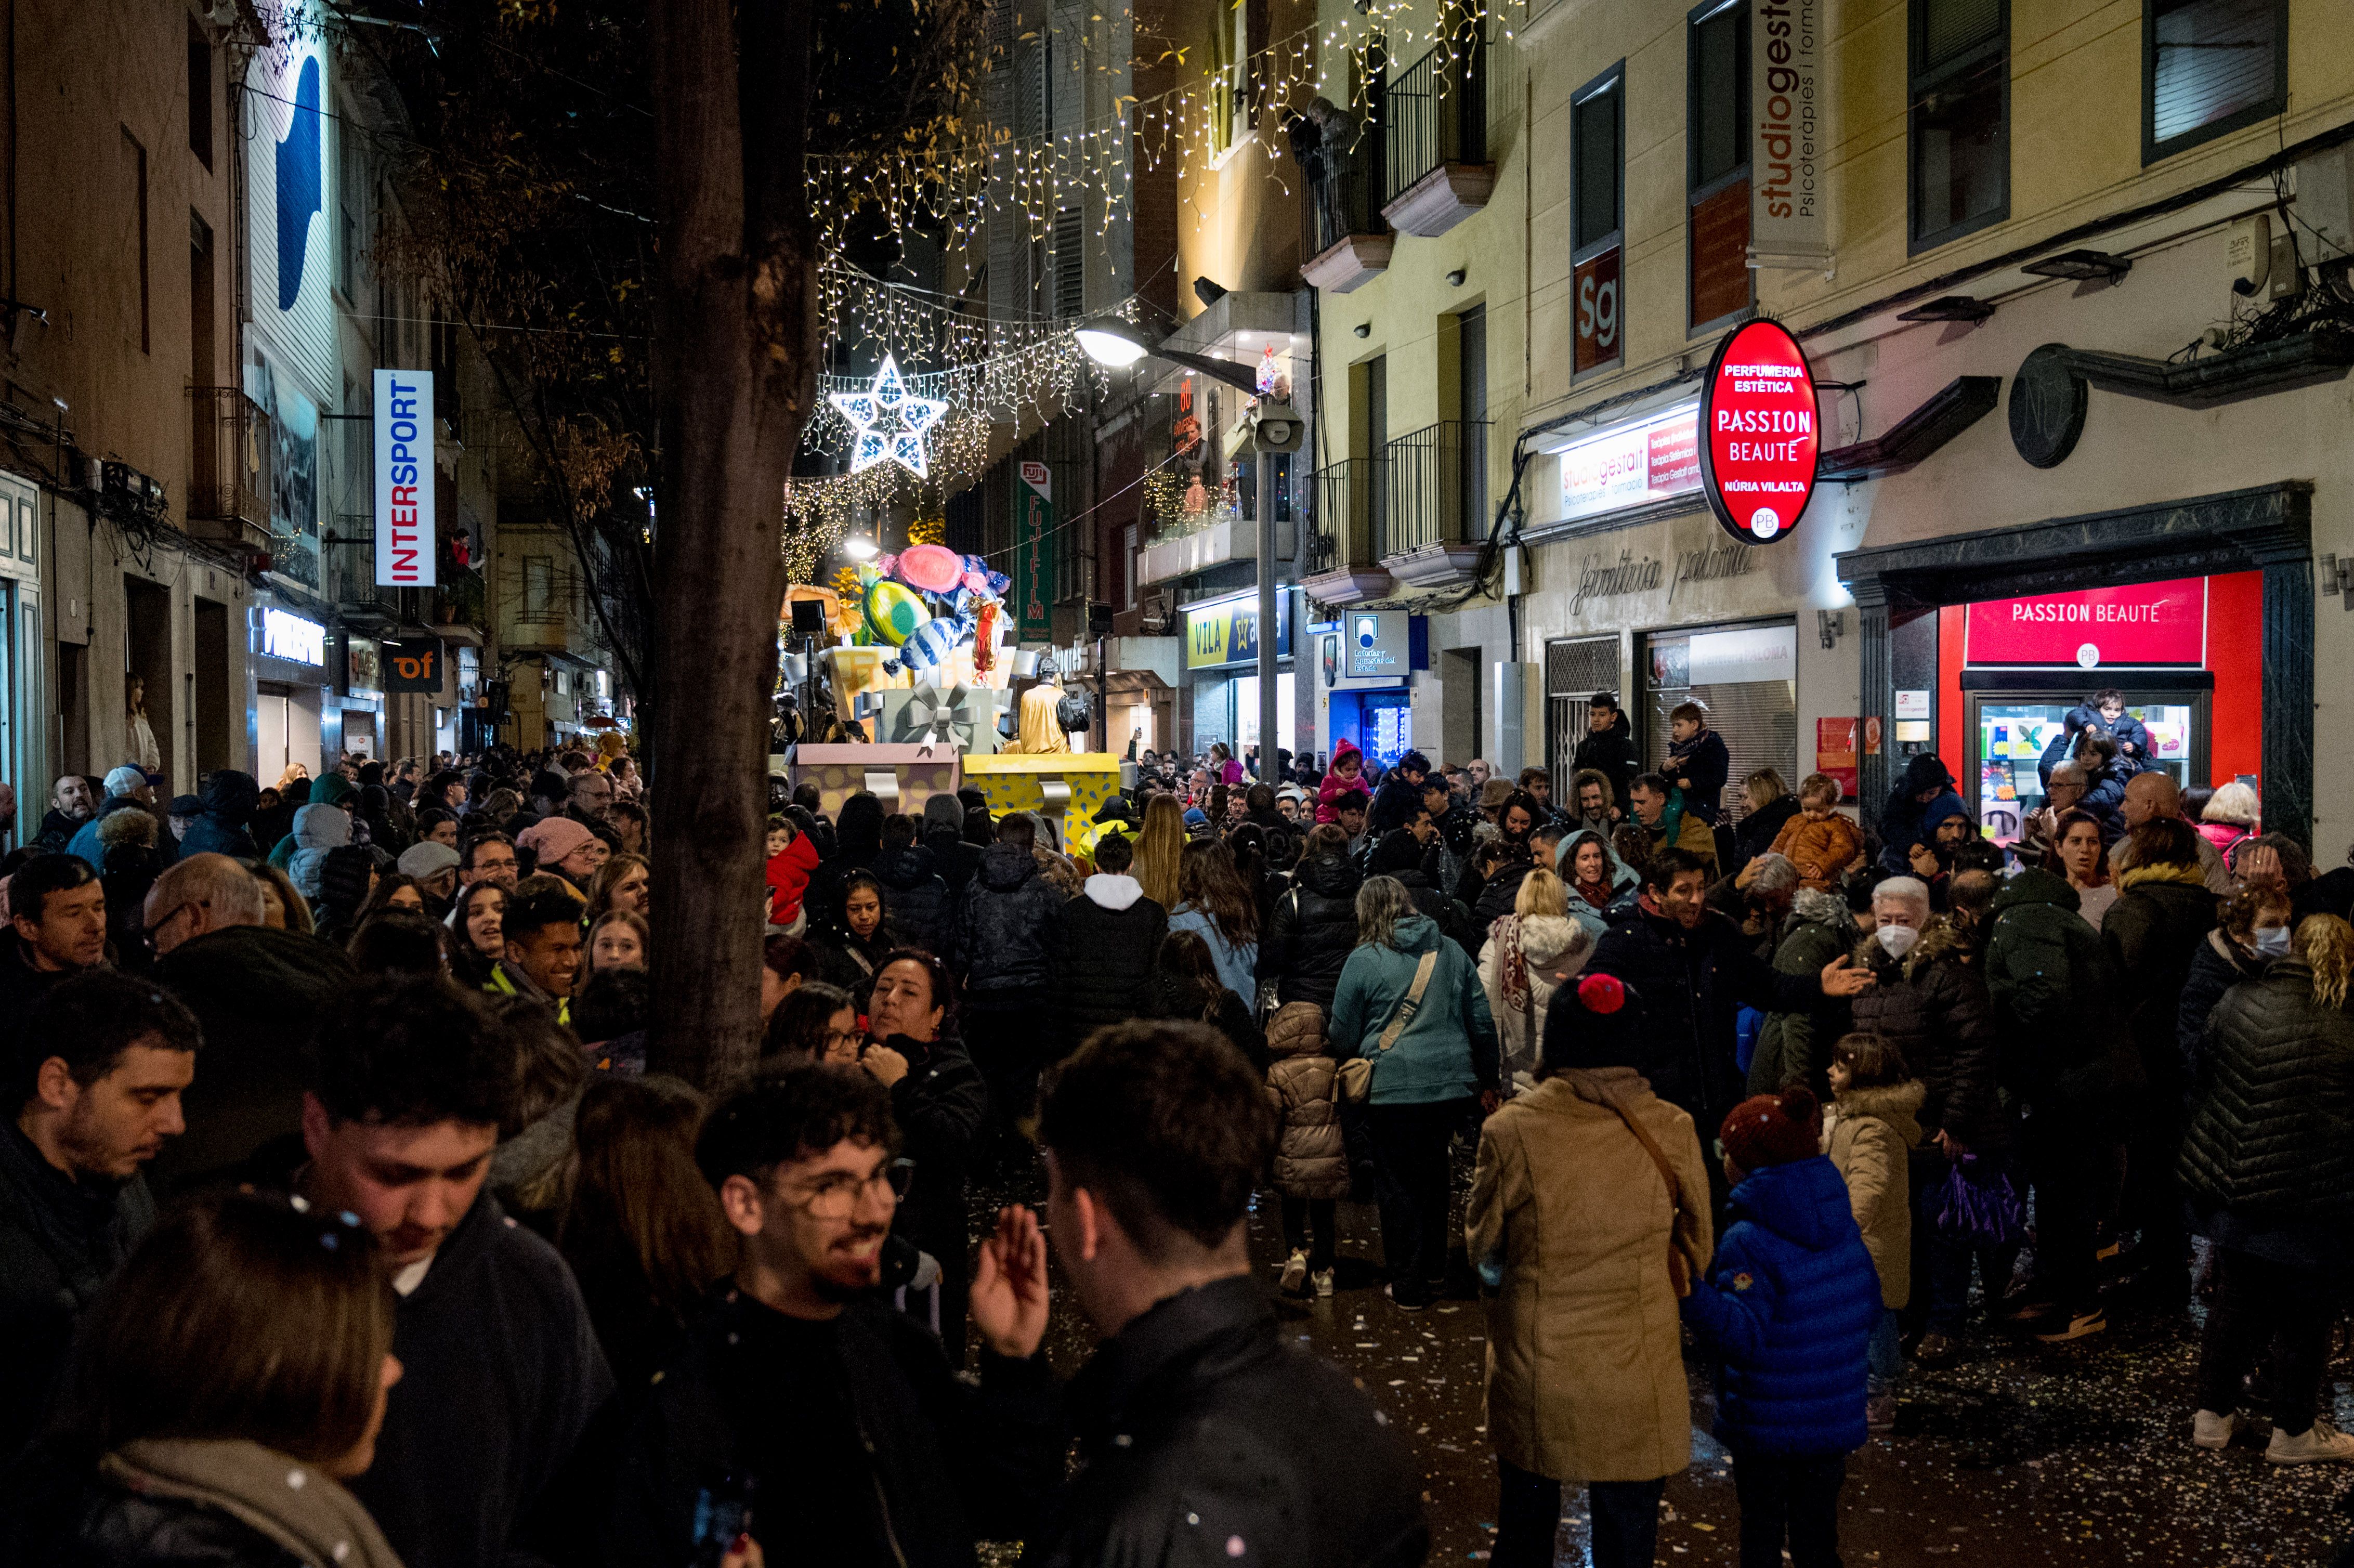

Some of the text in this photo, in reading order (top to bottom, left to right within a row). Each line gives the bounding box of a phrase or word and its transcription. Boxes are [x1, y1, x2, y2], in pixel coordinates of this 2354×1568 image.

[1760, 0, 1799, 218] studiogest
[1798, 76, 1817, 217] Psicoteràpies
[1579, 276, 1617, 347] Sg
[1724, 365, 1803, 377] PERFUMERIA
[1734, 379, 1794, 393] ESTÈTICA
[1718, 409, 1810, 433] PASSION
[1730, 436, 1809, 462] BEAUTÉ
[390, 378, 419, 581] INTERSPORT
[1025, 466, 1045, 482] FUJI
[1724, 479, 1805, 492] NÚRIA VILALTA
[1756, 515, 1774, 528] PB
[1027, 495, 1044, 620] FUJIFILM
[1668, 532, 1750, 605] paloma
[2012, 599, 2169, 623] PASSION BEAUTÉ
[1195, 619, 1221, 655] VILA
[1702, 645, 1788, 665] Ferreteria PALOMA
[2081, 649, 2095, 661] PB
